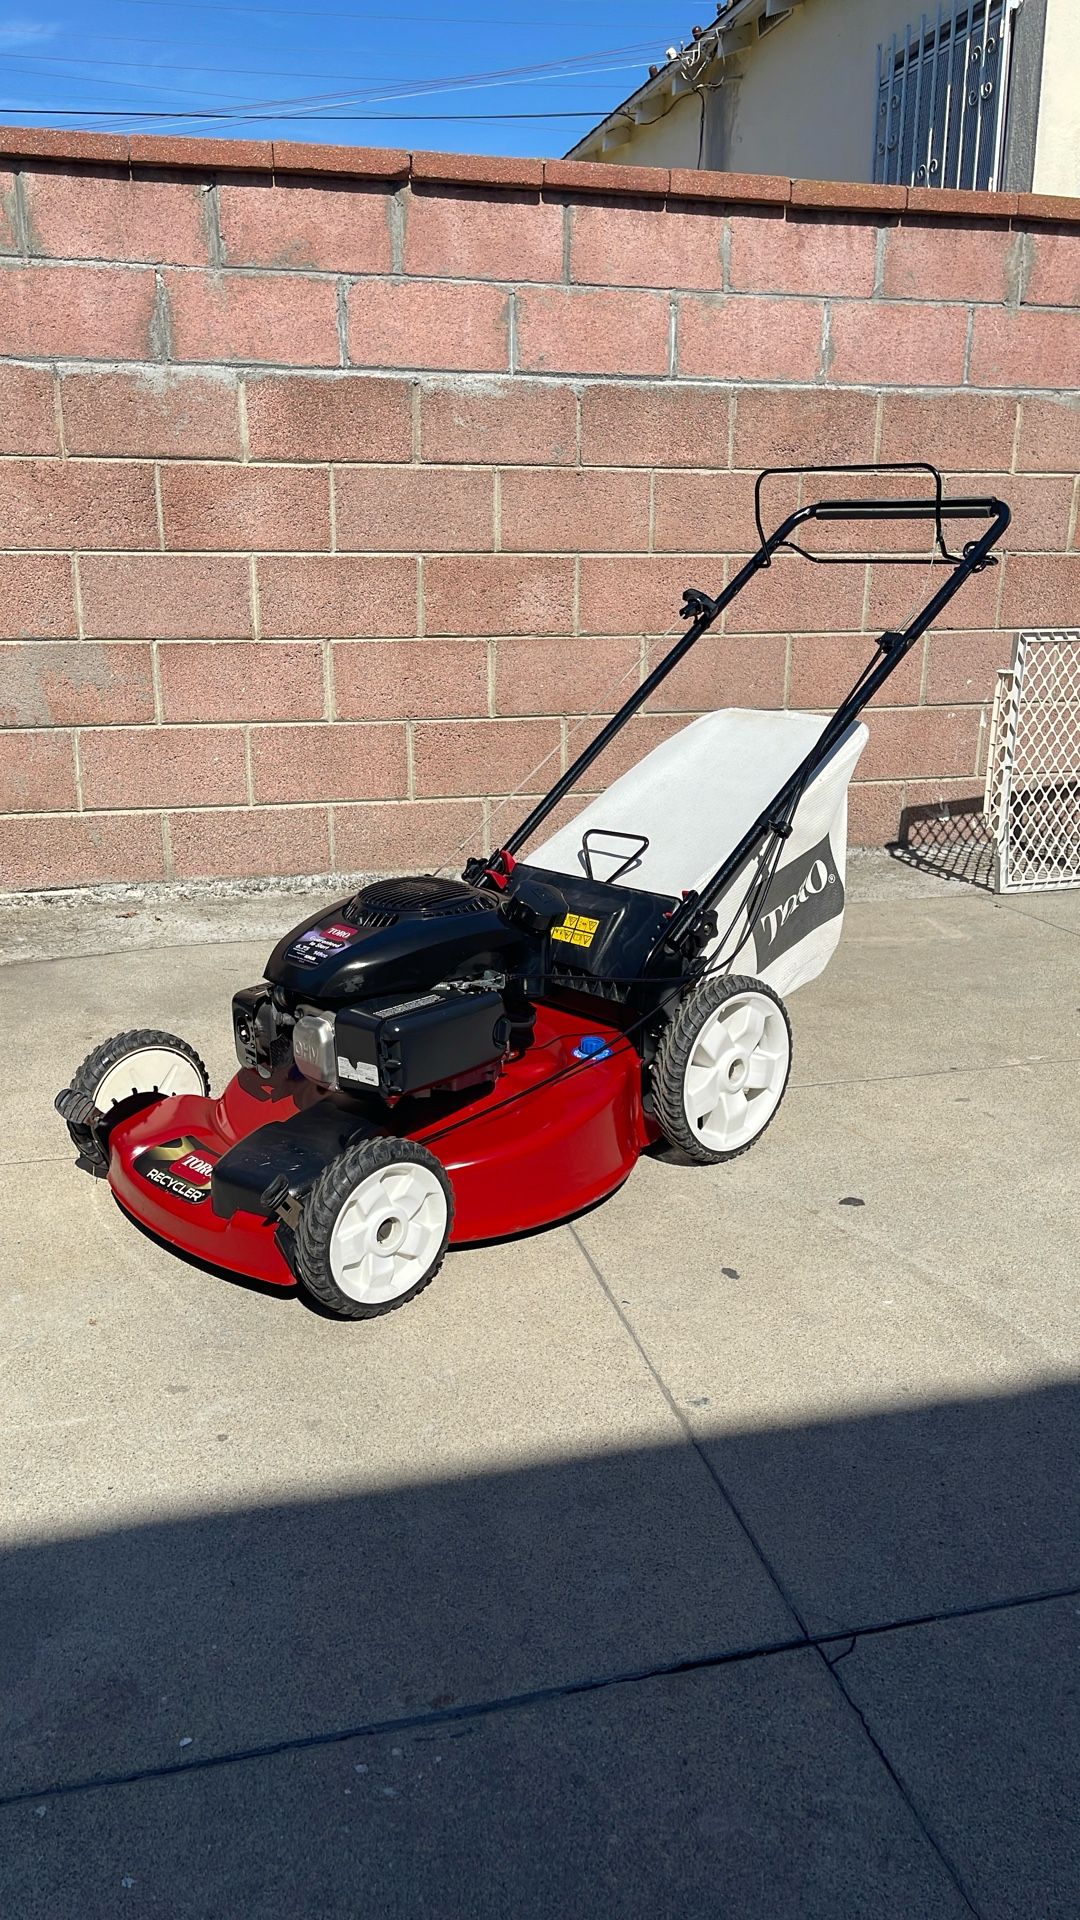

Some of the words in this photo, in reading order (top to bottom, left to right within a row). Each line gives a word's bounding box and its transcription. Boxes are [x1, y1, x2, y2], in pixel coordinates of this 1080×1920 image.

[328, 927, 351, 938] TORO
[181, 1155, 214, 1178] TOR
[146, 1168, 204, 1202] RECYCLER
